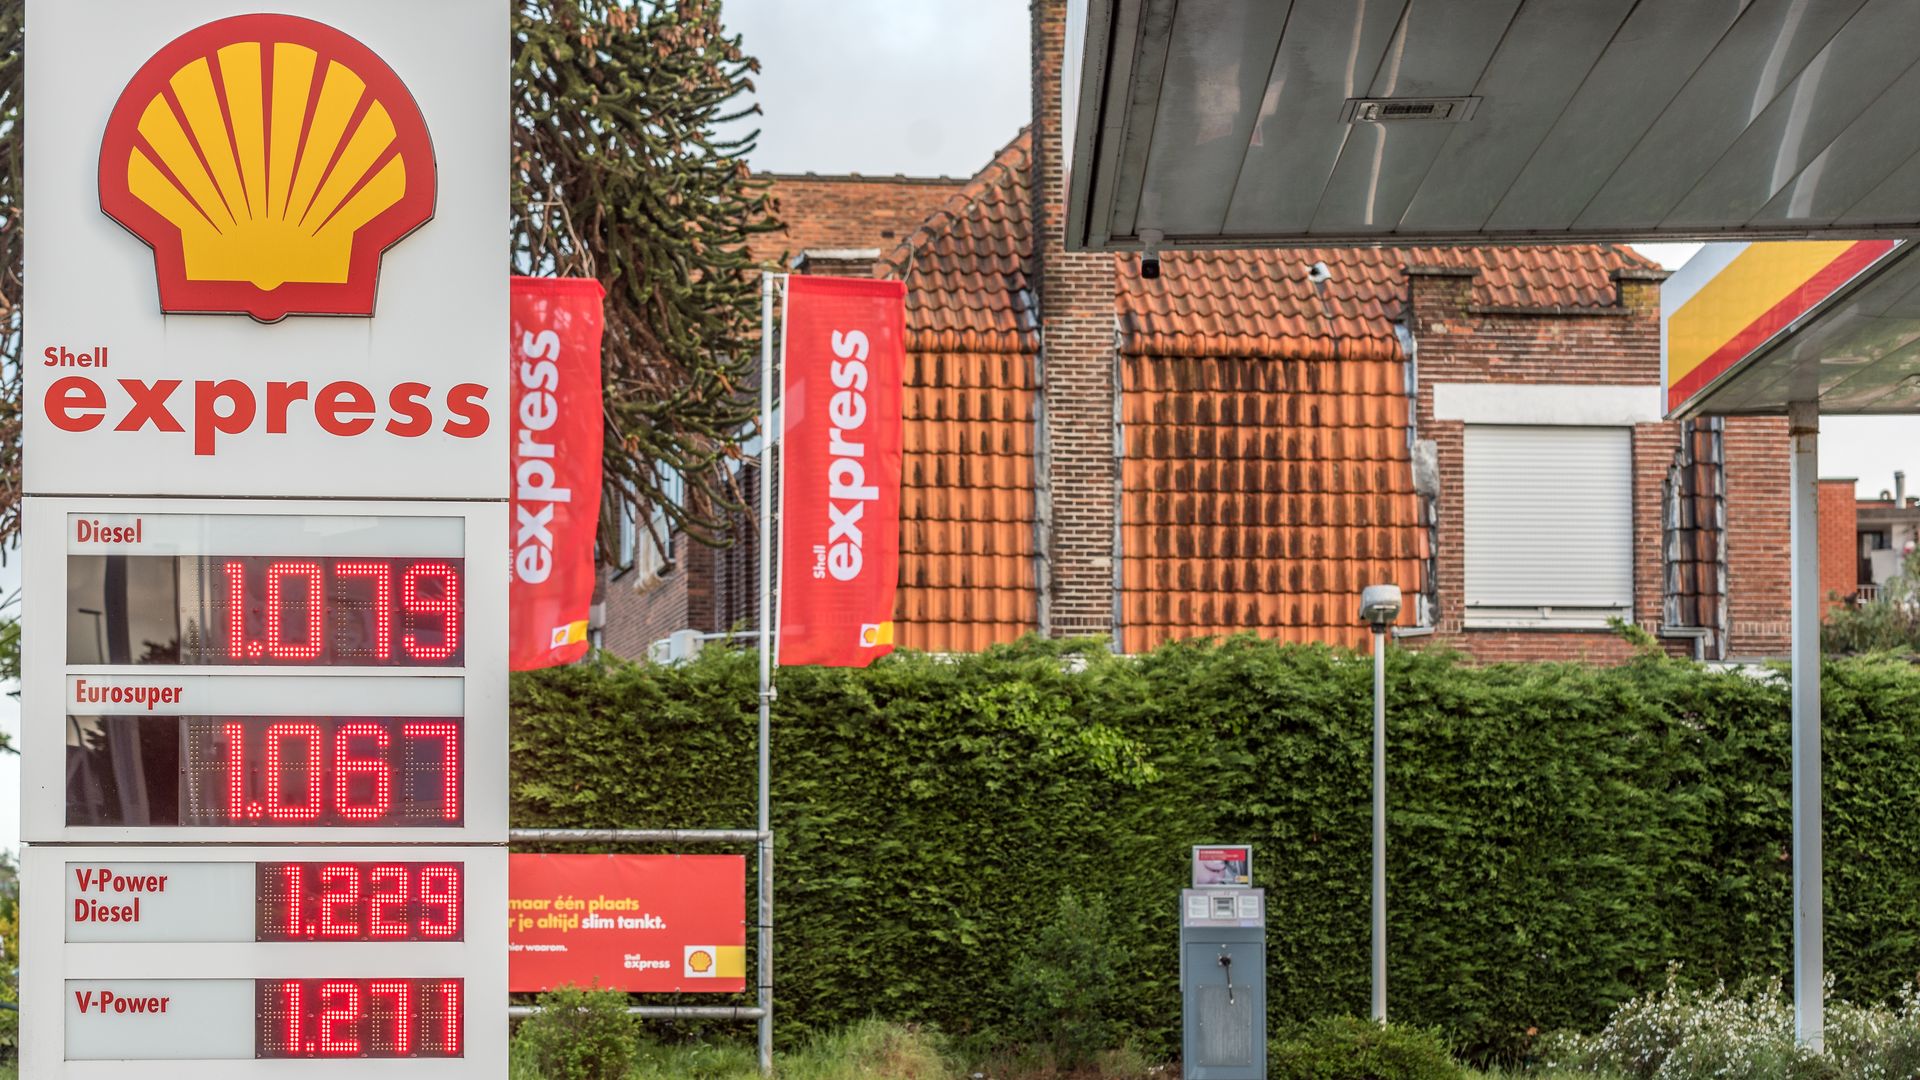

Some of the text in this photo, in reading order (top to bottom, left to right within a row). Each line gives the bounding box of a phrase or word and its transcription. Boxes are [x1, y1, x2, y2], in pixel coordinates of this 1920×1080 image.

[44, 346, 108, 368] Shell
[44, 376, 491, 456] express
[516, 330, 571, 584] express
[827, 329, 880, 581] express
[77, 519, 142, 543] Diesel
[813, 545, 826, 579] Shell
[226, 562, 458, 659] 1.079
[76, 680, 183, 709] Eurosuper
[226, 723, 458, 820] 1.067
[76, 868, 167, 893] V-Power
[75, 897, 140, 922] Diesel
[284, 866, 458, 936] 1.229
[554, 895, 585, 910] één
[588, 896, 640, 913] plaats
[518, 913, 533, 932] je
[537, 913, 579, 932] altijd
[582, 913, 614, 929] slim
[617, 913, 667, 930] tankt.
[624, 960, 671, 971] express
[75, 991, 169, 1014] V-Power
[284, 983, 458, 1053] 1.271
